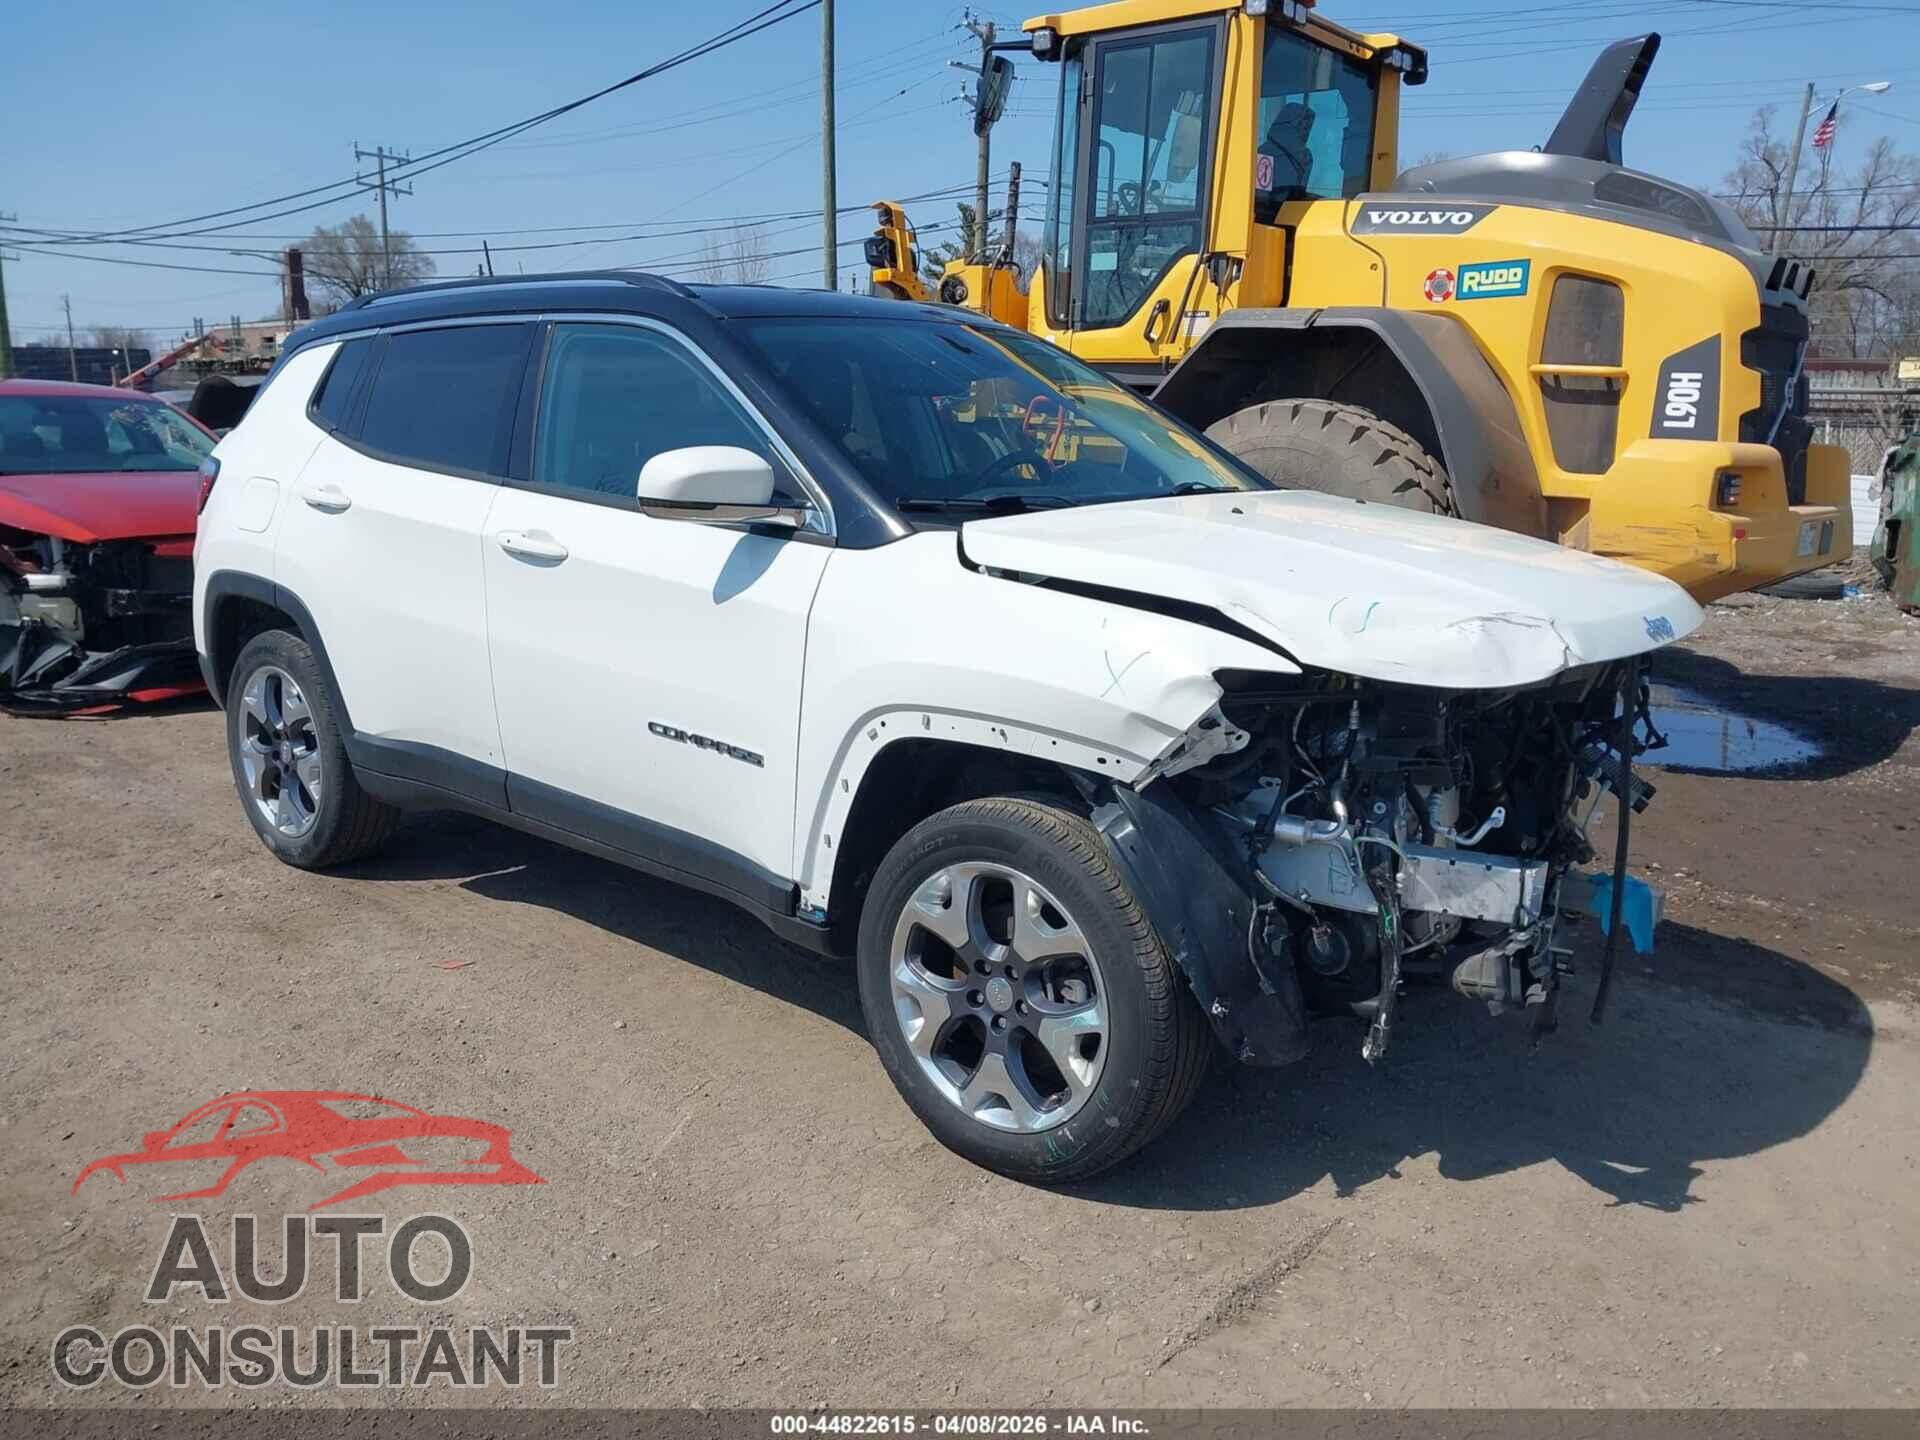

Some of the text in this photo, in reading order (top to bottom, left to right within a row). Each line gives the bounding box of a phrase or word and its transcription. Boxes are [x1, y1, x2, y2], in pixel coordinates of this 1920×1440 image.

[1368, 211, 1473, 225] VOLVO
[1463, 267, 1523, 293] RUDD
[1663, 372, 1703, 428] L90H
